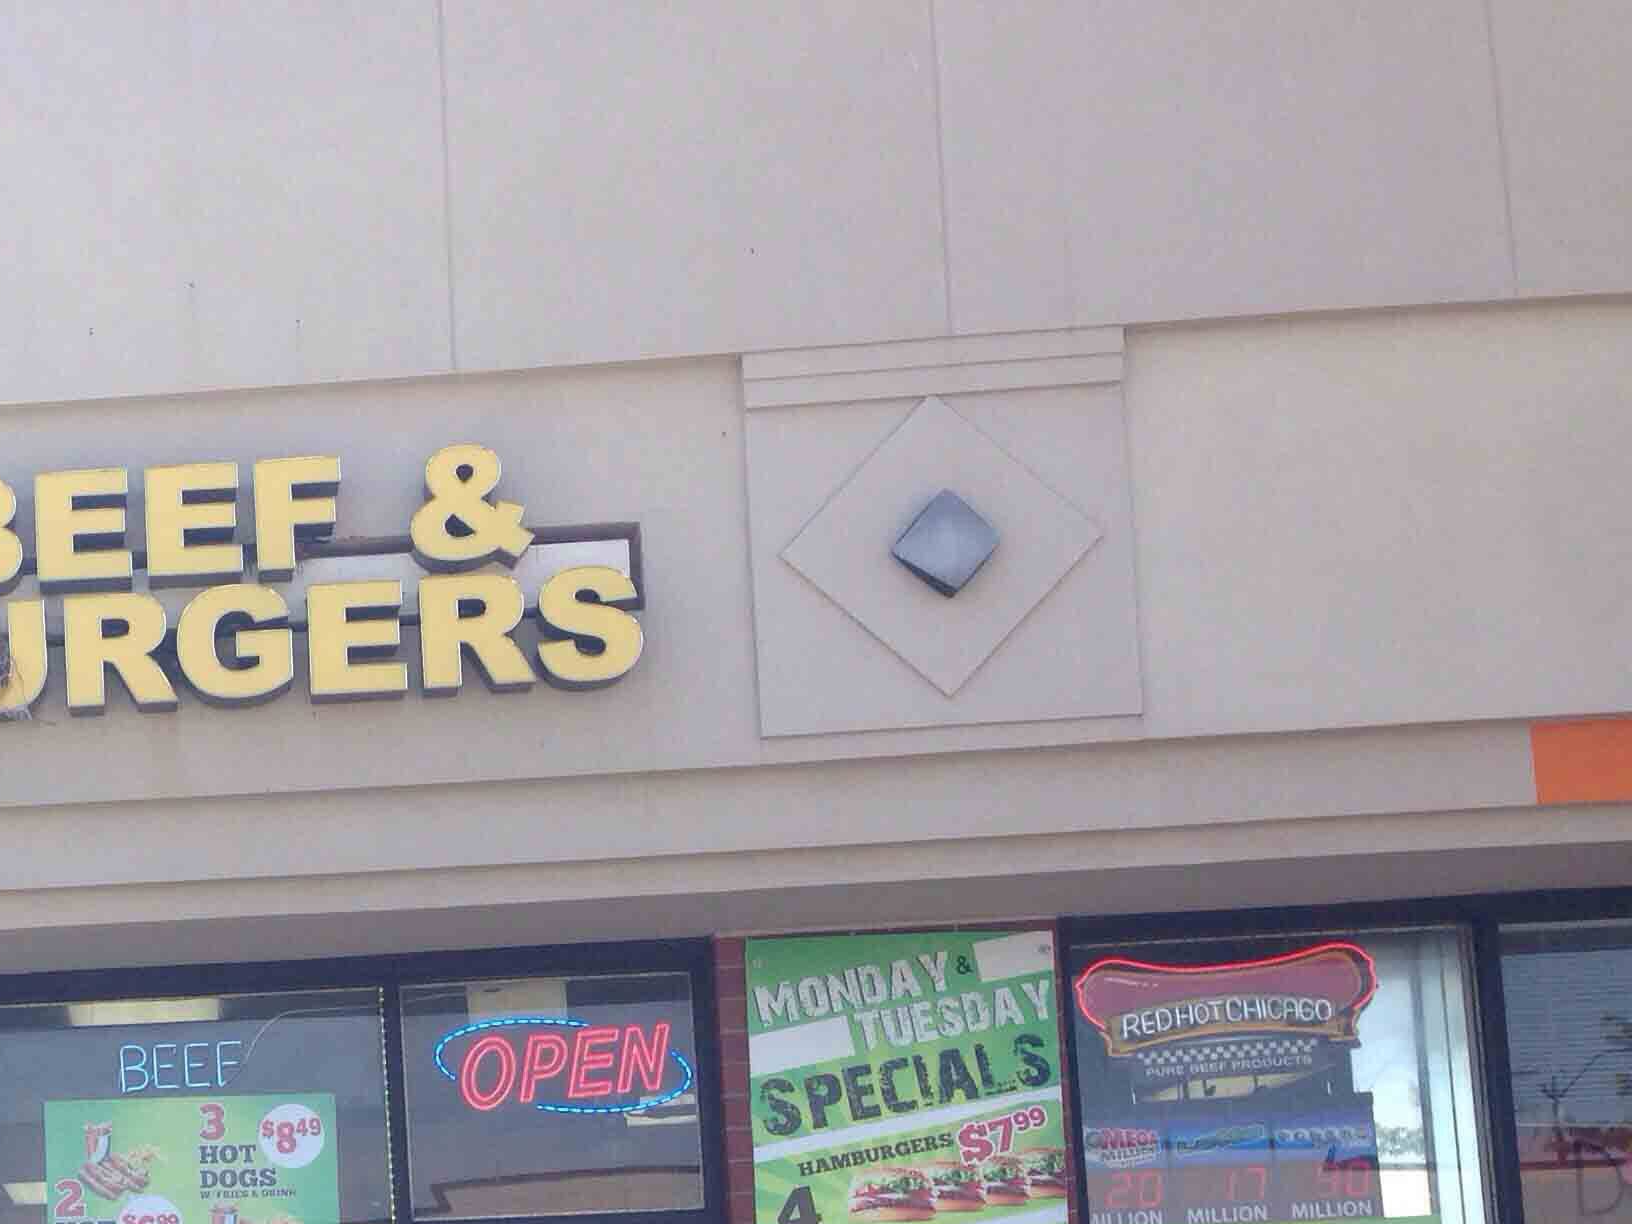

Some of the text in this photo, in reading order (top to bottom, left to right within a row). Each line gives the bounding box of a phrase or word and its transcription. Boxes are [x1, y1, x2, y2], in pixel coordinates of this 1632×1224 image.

[409, 443, 536, 571] &
[753, 950, 974, 1027] MONDAY &
[854, 979, 1050, 1051] TUESDAY
[119, 1040, 241, 1093] BEEF
[460, 1022, 671, 1111] OPEN
[199, 1102, 226, 1141] 3
[199, 1144, 257, 1165] HOT
[797, 1132, 953, 1177] HAMBURGERS
[54, 1179, 85, 1217] 2
[200, 1167, 277, 1190] DOGS
[1290, 1200, 1374, 1220] MILLION
